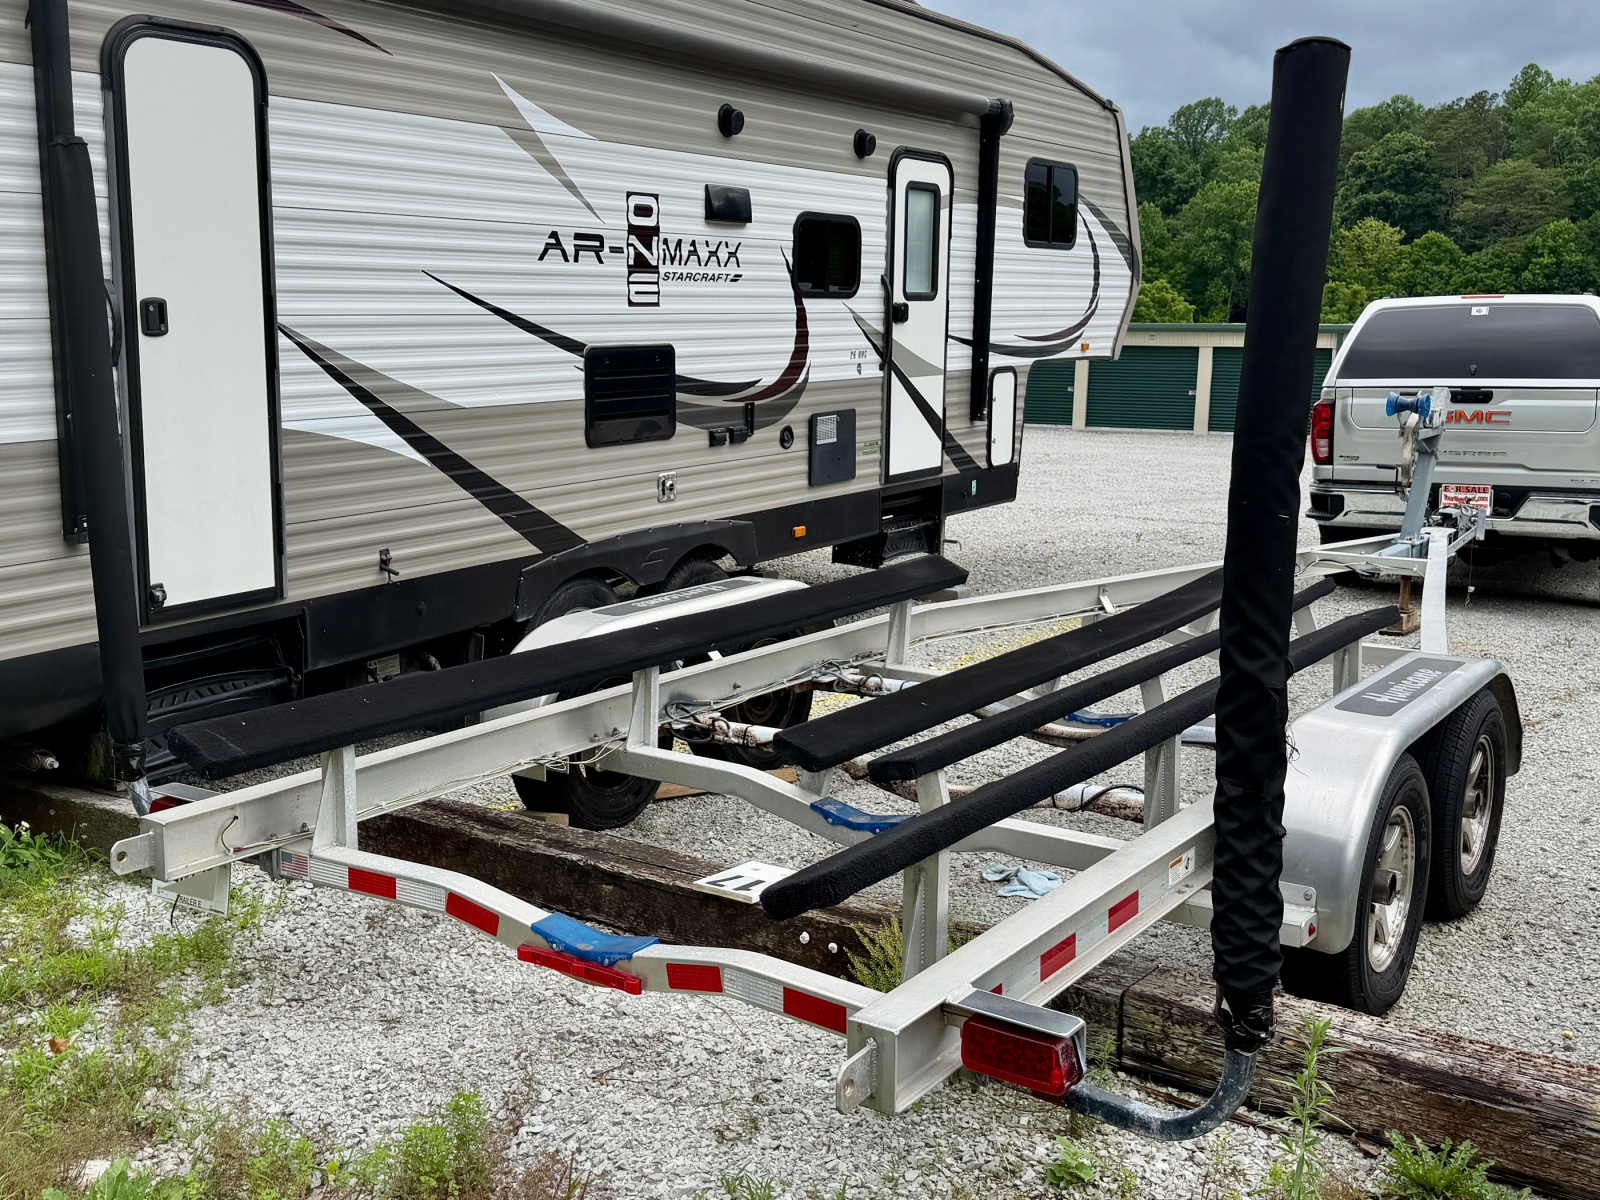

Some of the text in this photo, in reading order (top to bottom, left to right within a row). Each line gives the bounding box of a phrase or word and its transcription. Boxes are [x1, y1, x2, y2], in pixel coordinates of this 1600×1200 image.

[662, 237, 742, 268] MAXX
[662, 271, 732, 283] STARCRAFT
[1465, 486, 1490, 494] SALE
[1361, 667, 1443, 704] Hurricane
[705, 874, 767, 892] 17
